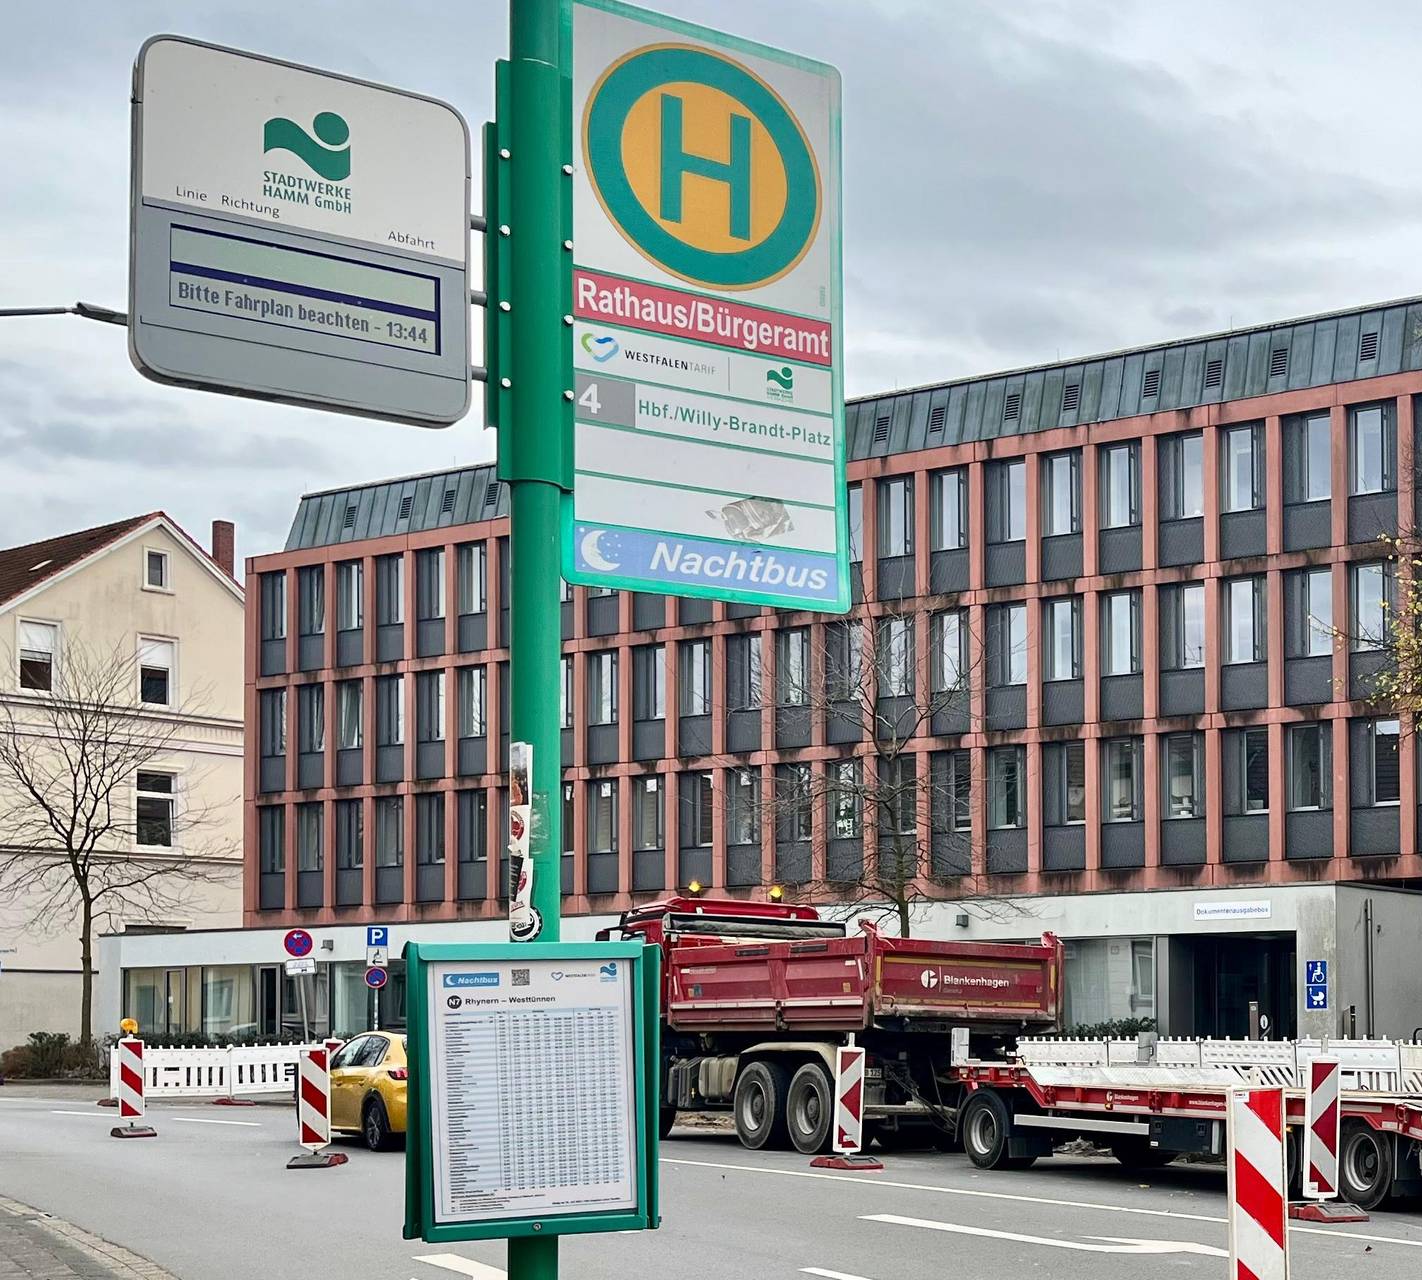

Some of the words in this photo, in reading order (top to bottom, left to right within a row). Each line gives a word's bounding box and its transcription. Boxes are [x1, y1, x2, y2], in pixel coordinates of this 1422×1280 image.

[659, 93, 751, 241] H
[176, 185, 208, 202] Linie
[263, 170, 352, 200] STADTWERKE
[221, 194, 280, 219] Richtung
[263, 184, 310, 206] HAMM
[314, 195, 352, 214] GmbH
[387, 230, 436, 250] Abfahrt
[178, 281, 219, 305] Bitte
[224, 290, 293, 319] Fahrplan
[298, 303, 369, 333] beachten
[386, 322, 427, 344] 13:44
[577, 277, 829, 358] Rathaus/Bürgeramt
[578, 383, 602, 414] 4
[638, 399, 831, 447] Hbf./Willy-Brandt-Platz
[650, 542, 828, 590] Nachtbus
[371, 929, 384, 944] P
[457, 976, 498, 985] Nachtbus
[943, 975, 1010, 989] Blankenhagen
[448, 998, 461, 1007] N7
[465, 998, 499, 1006] Rhynern
[508, 996, 556, 1004] Westtünnen
